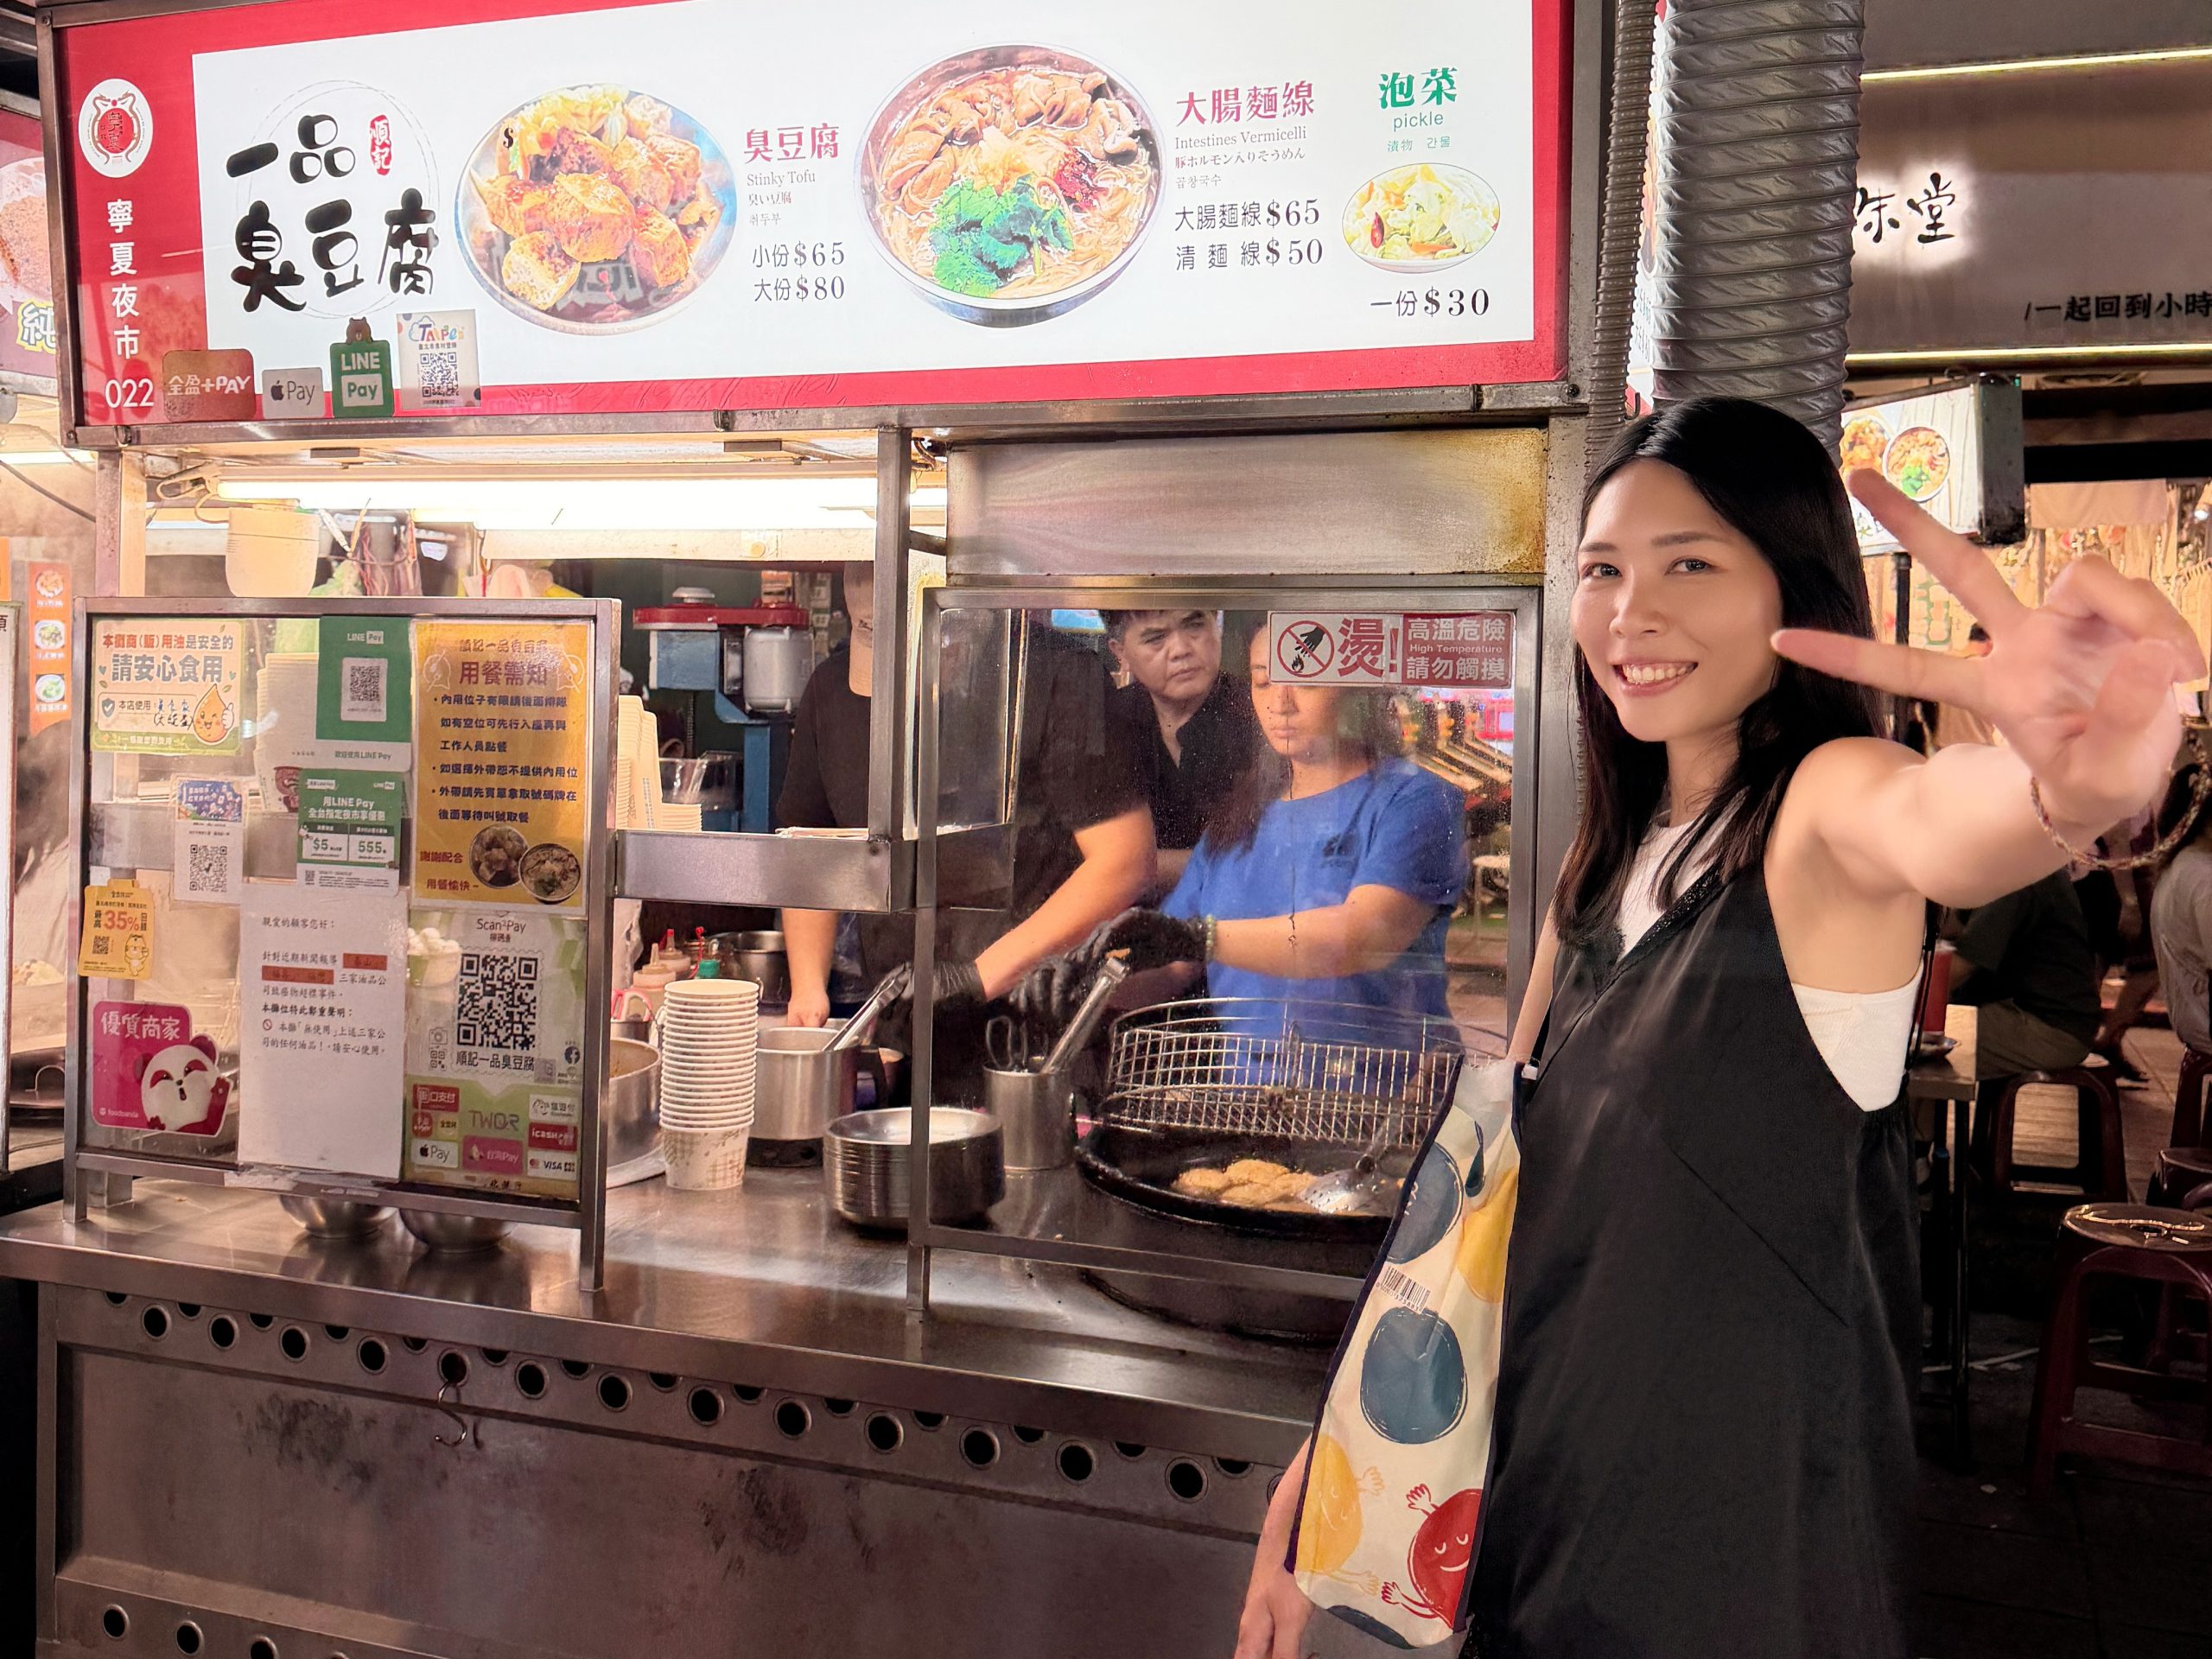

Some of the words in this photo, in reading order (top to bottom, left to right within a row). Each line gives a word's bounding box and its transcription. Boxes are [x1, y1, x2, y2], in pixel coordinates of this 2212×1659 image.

[1378, 67, 1458, 109] 泡菜
[1176, 80, 1315, 127] 大腸麵線
[1394, 111, 1444, 132] pickle
[370, 118, 391, 171] 順記
[744, 123, 839, 164] 臭豆腐
[1175, 133, 1237, 149] Intestines
[1241, 125, 1306, 143] Vermicelli
[226, 114, 355, 183] 一品
[747, 173, 785, 188] Stinky
[788, 169, 816, 184] Tofu
[231, 188, 439, 312] 臭豆腐
[106, 198, 140, 360] 寧夏夜市
[340, 352, 381, 371] LINE
[105, 377, 154, 409] 022
[168, 374, 251, 396] 全盈+PAY
[287, 381, 315, 405] Pay
[347, 382, 378, 401] Pay
[346, 632, 365, 642] LINE
[369, 632, 382, 644] Pay
[1408, 618, 1504, 642] 高溫危險
[1409, 643, 1433, 654] High
[1436, 644, 1503, 654] Temperature
[111, 653, 223, 683] 請安心食用
[1406, 657, 1504, 681] 請勿觸摸
[378, 752, 391, 761] Pay
[356, 798, 374, 810] Pay
[313, 838, 329, 851] $5
[104, 909, 140, 931] 35%
[100, 1010, 181, 1041] 優質商家
[454, 1050, 535, 1072] 順記一品臭豆腐
[107, 1108, 139, 1118] foodpanda
[430, 1145, 450, 1163] Pay
[543, 1160, 563, 1171] VISA
